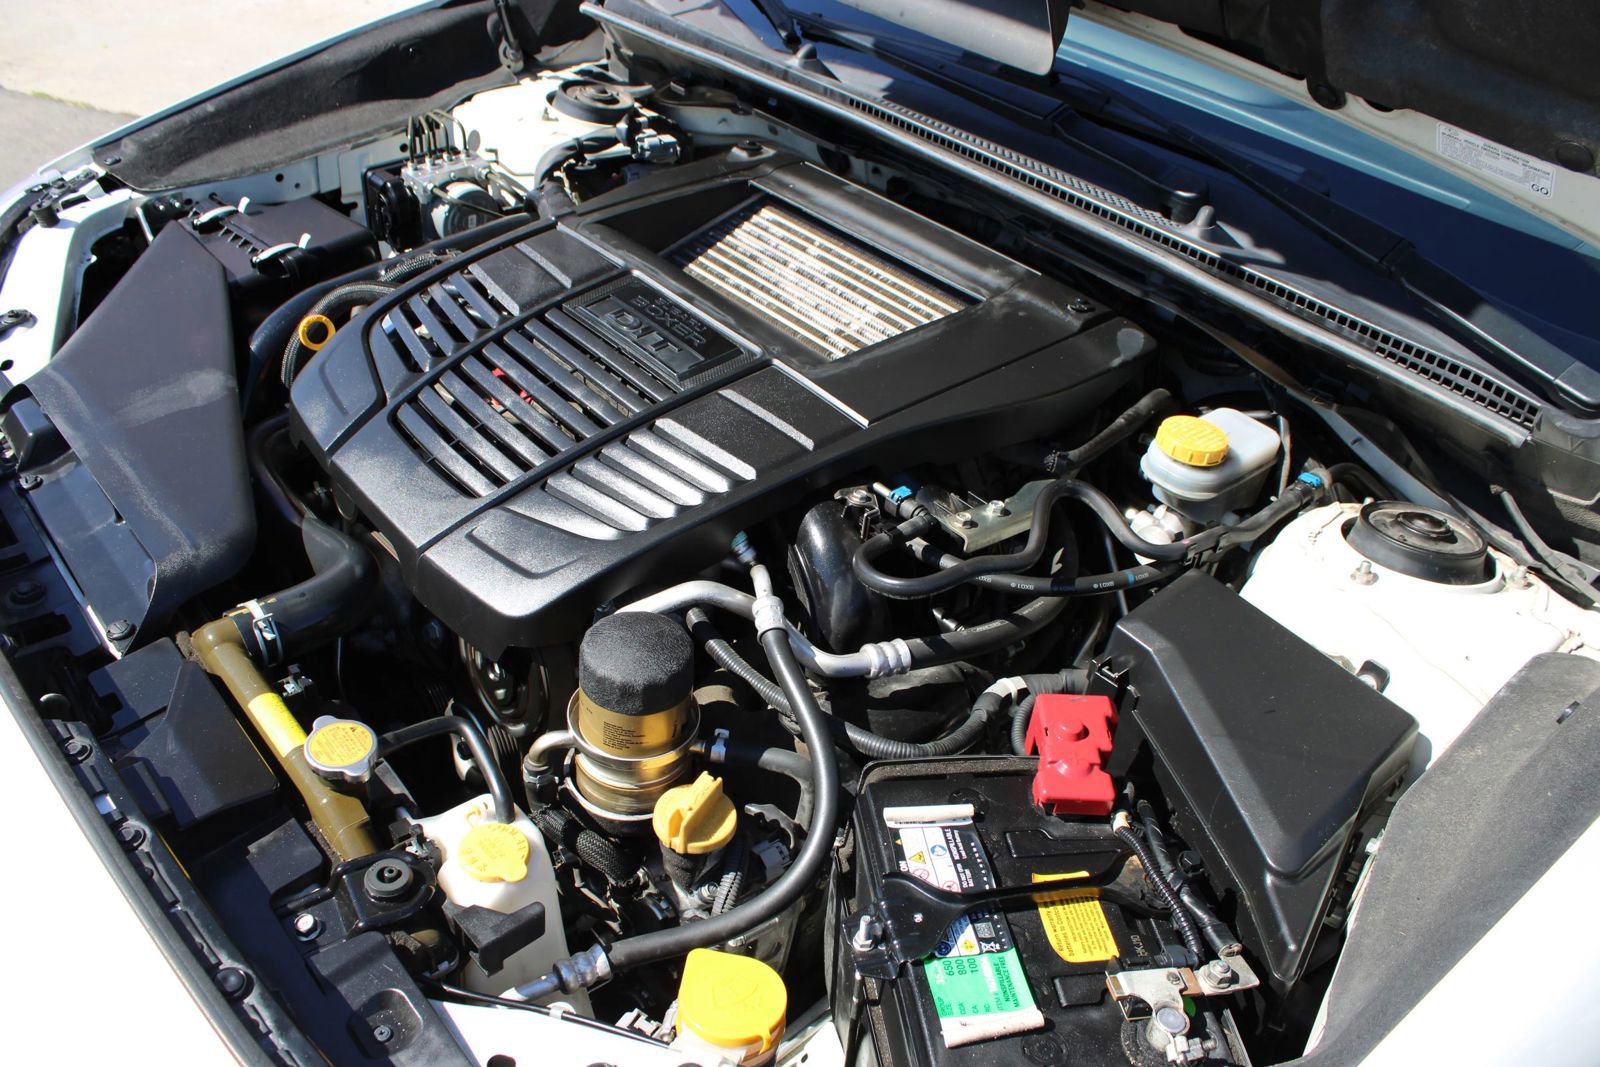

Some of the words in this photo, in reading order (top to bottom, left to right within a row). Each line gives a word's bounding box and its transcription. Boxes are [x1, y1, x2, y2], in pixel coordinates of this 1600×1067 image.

[604, 307, 682, 352] DIT
[629, 295, 707, 346] BOXER
[943, 960, 954, 977] 650
[955, 959, 967, 976] 800
[967, 958, 978, 974] 100
[993, 963, 1010, 1002] NONSPILLABLE
[1002, 970, 1020, 1008] MAINTENANCE
